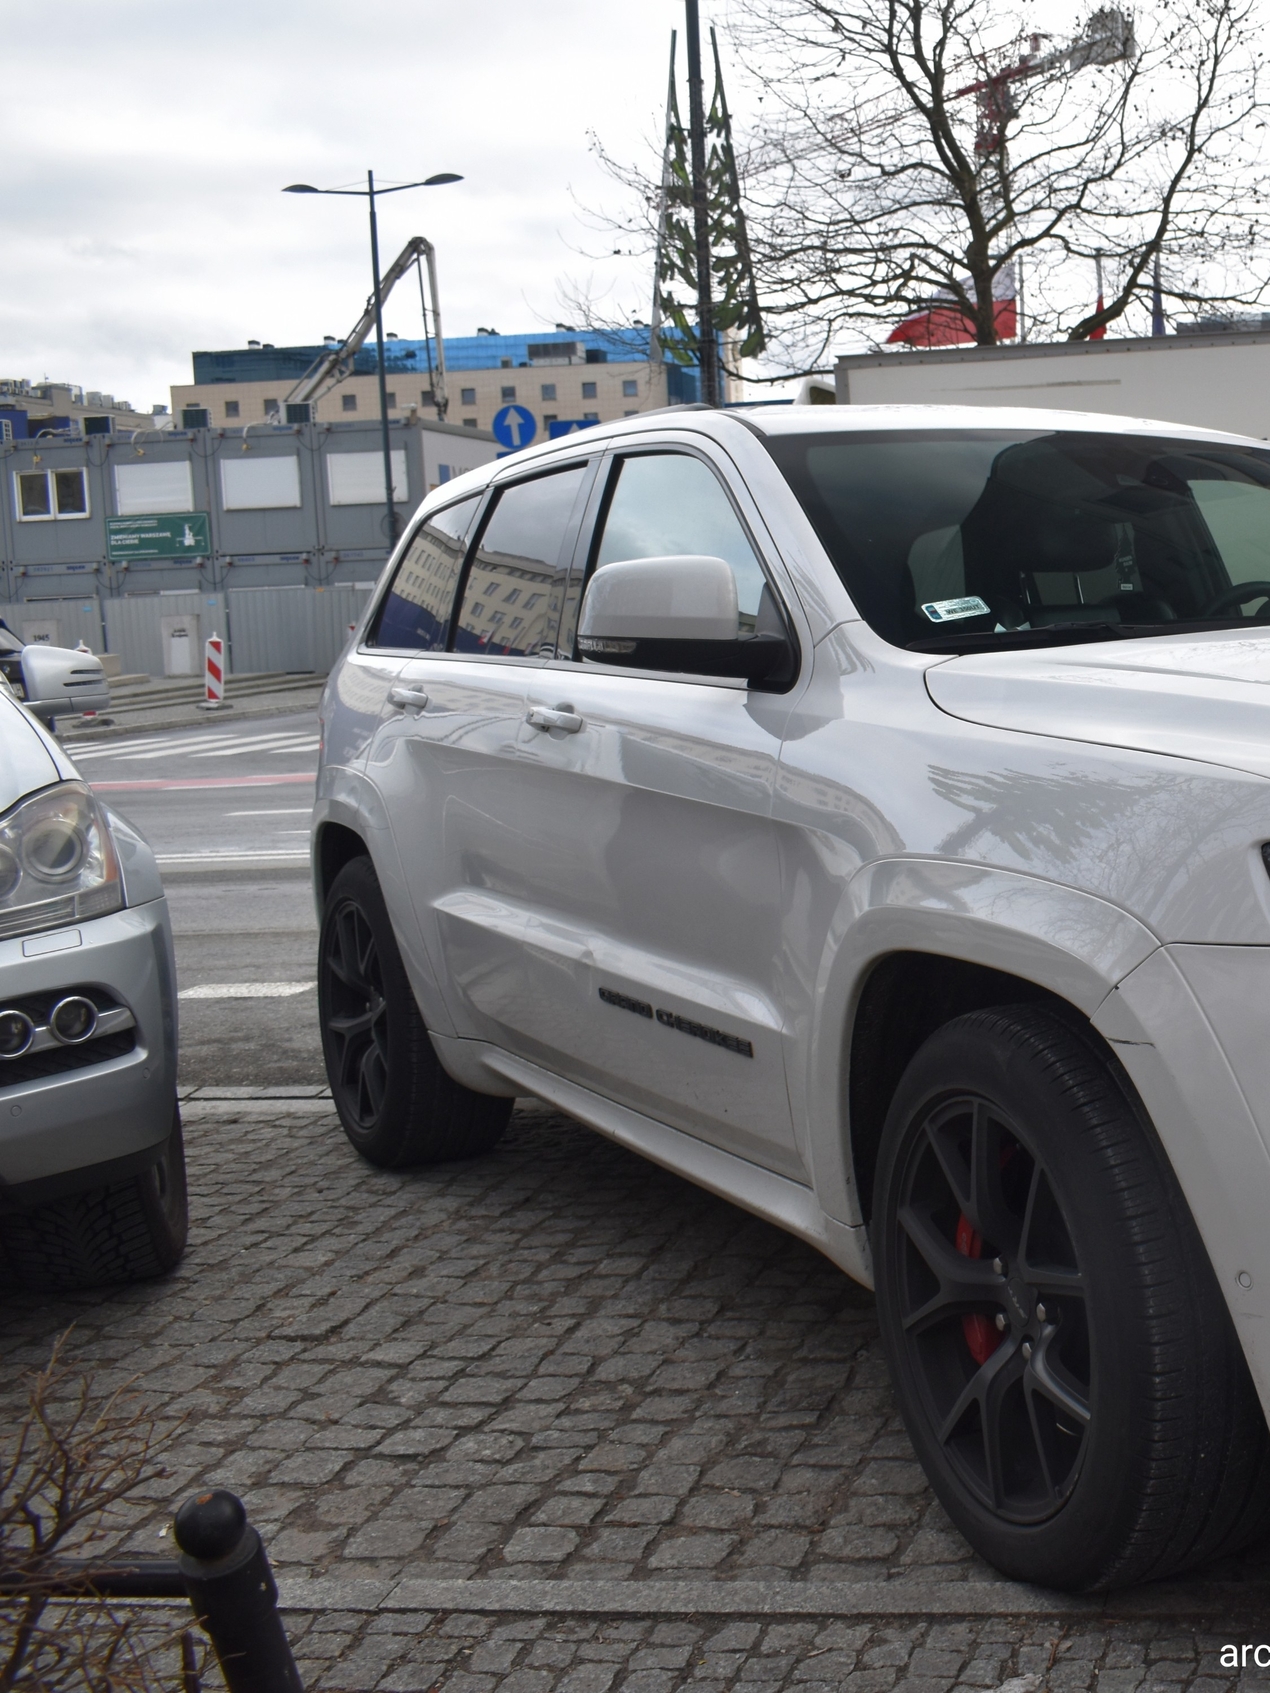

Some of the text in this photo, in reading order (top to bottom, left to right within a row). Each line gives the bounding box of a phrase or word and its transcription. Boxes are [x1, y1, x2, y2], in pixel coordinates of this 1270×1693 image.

[33, 633, 50, 642] 1945
[598, 987, 754, 1058] GRAND CHEROKEE
